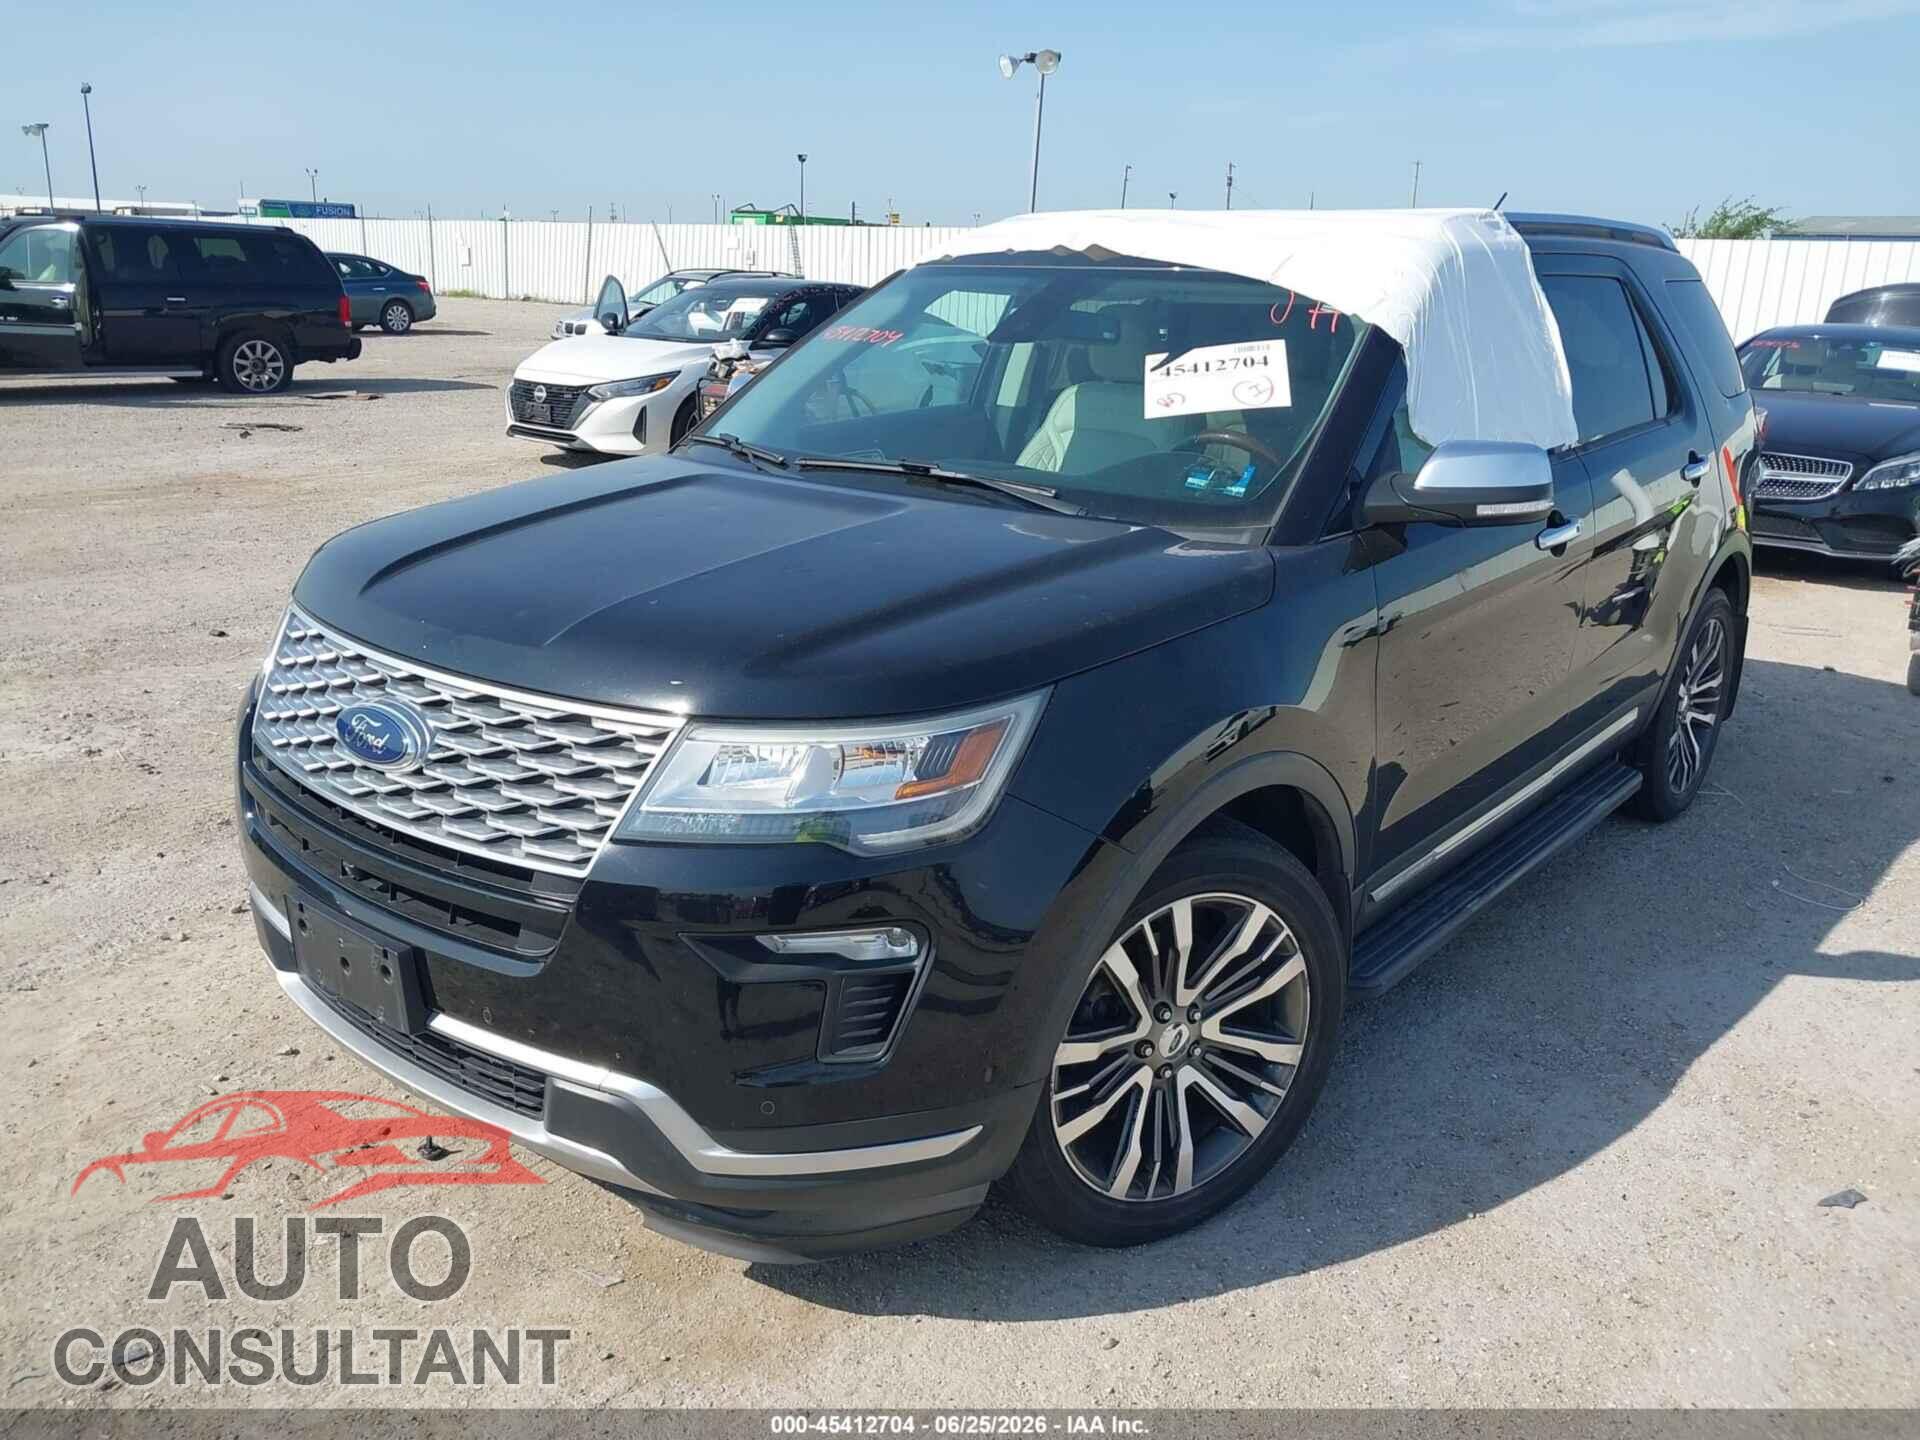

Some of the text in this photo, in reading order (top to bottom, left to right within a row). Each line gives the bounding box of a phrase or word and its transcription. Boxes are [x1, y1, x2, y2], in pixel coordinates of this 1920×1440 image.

[315, 206, 351, 217] FUSION
[1159, 355, 1270, 378] 45412704
[345, 713, 391, 754] Ford
